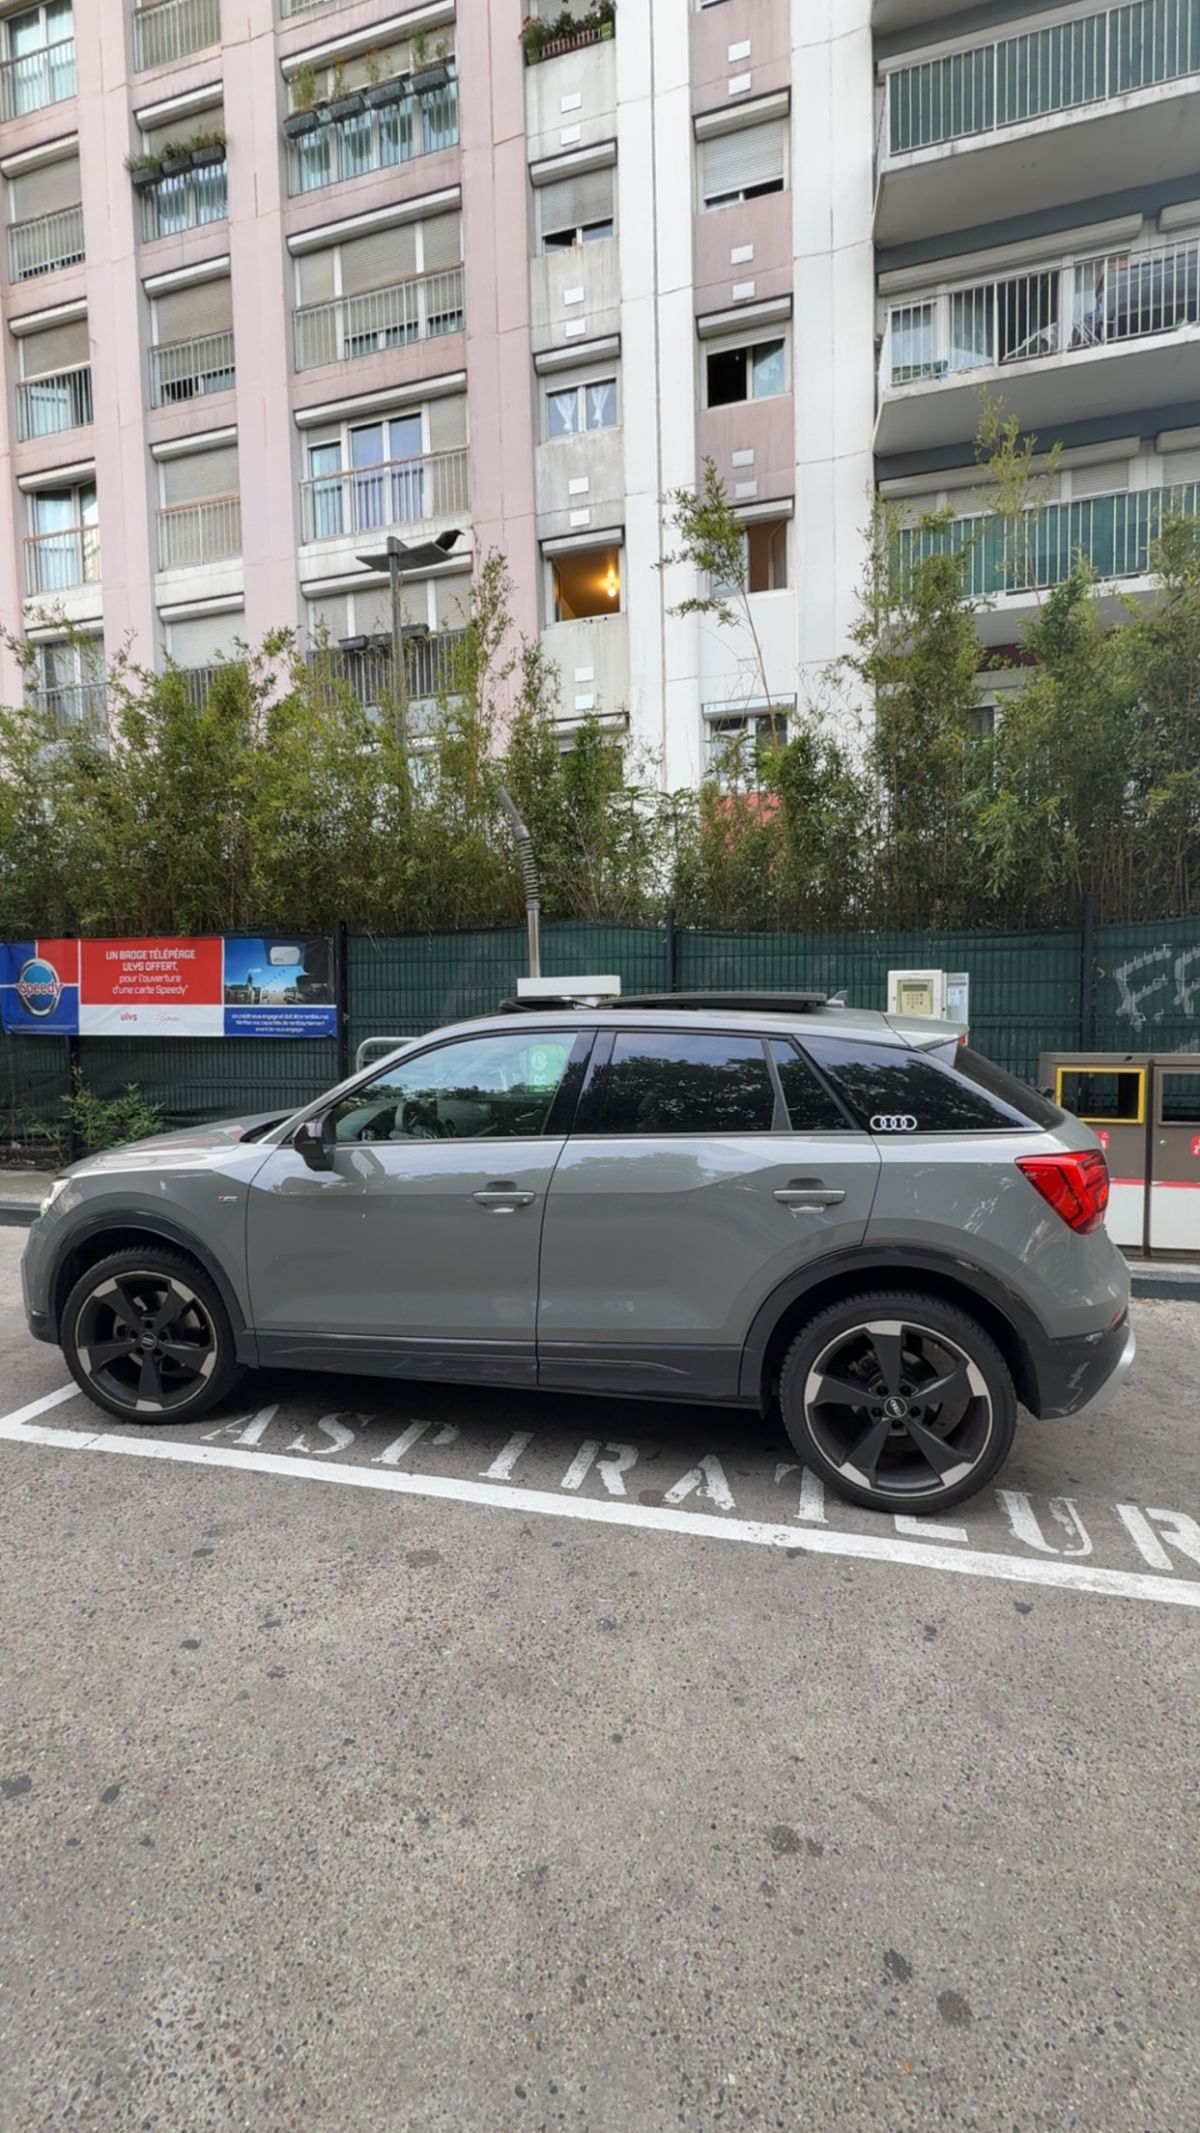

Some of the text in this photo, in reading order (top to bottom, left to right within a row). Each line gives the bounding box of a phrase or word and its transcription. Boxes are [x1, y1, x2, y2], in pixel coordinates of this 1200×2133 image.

[105, 951, 118, 960] UN
[122, 961, 144, 971] ULYS
[119, 975, 137, 984] pour
[16, 981, 64, 998] Speedy
[134, 986, 155, 994] carte
